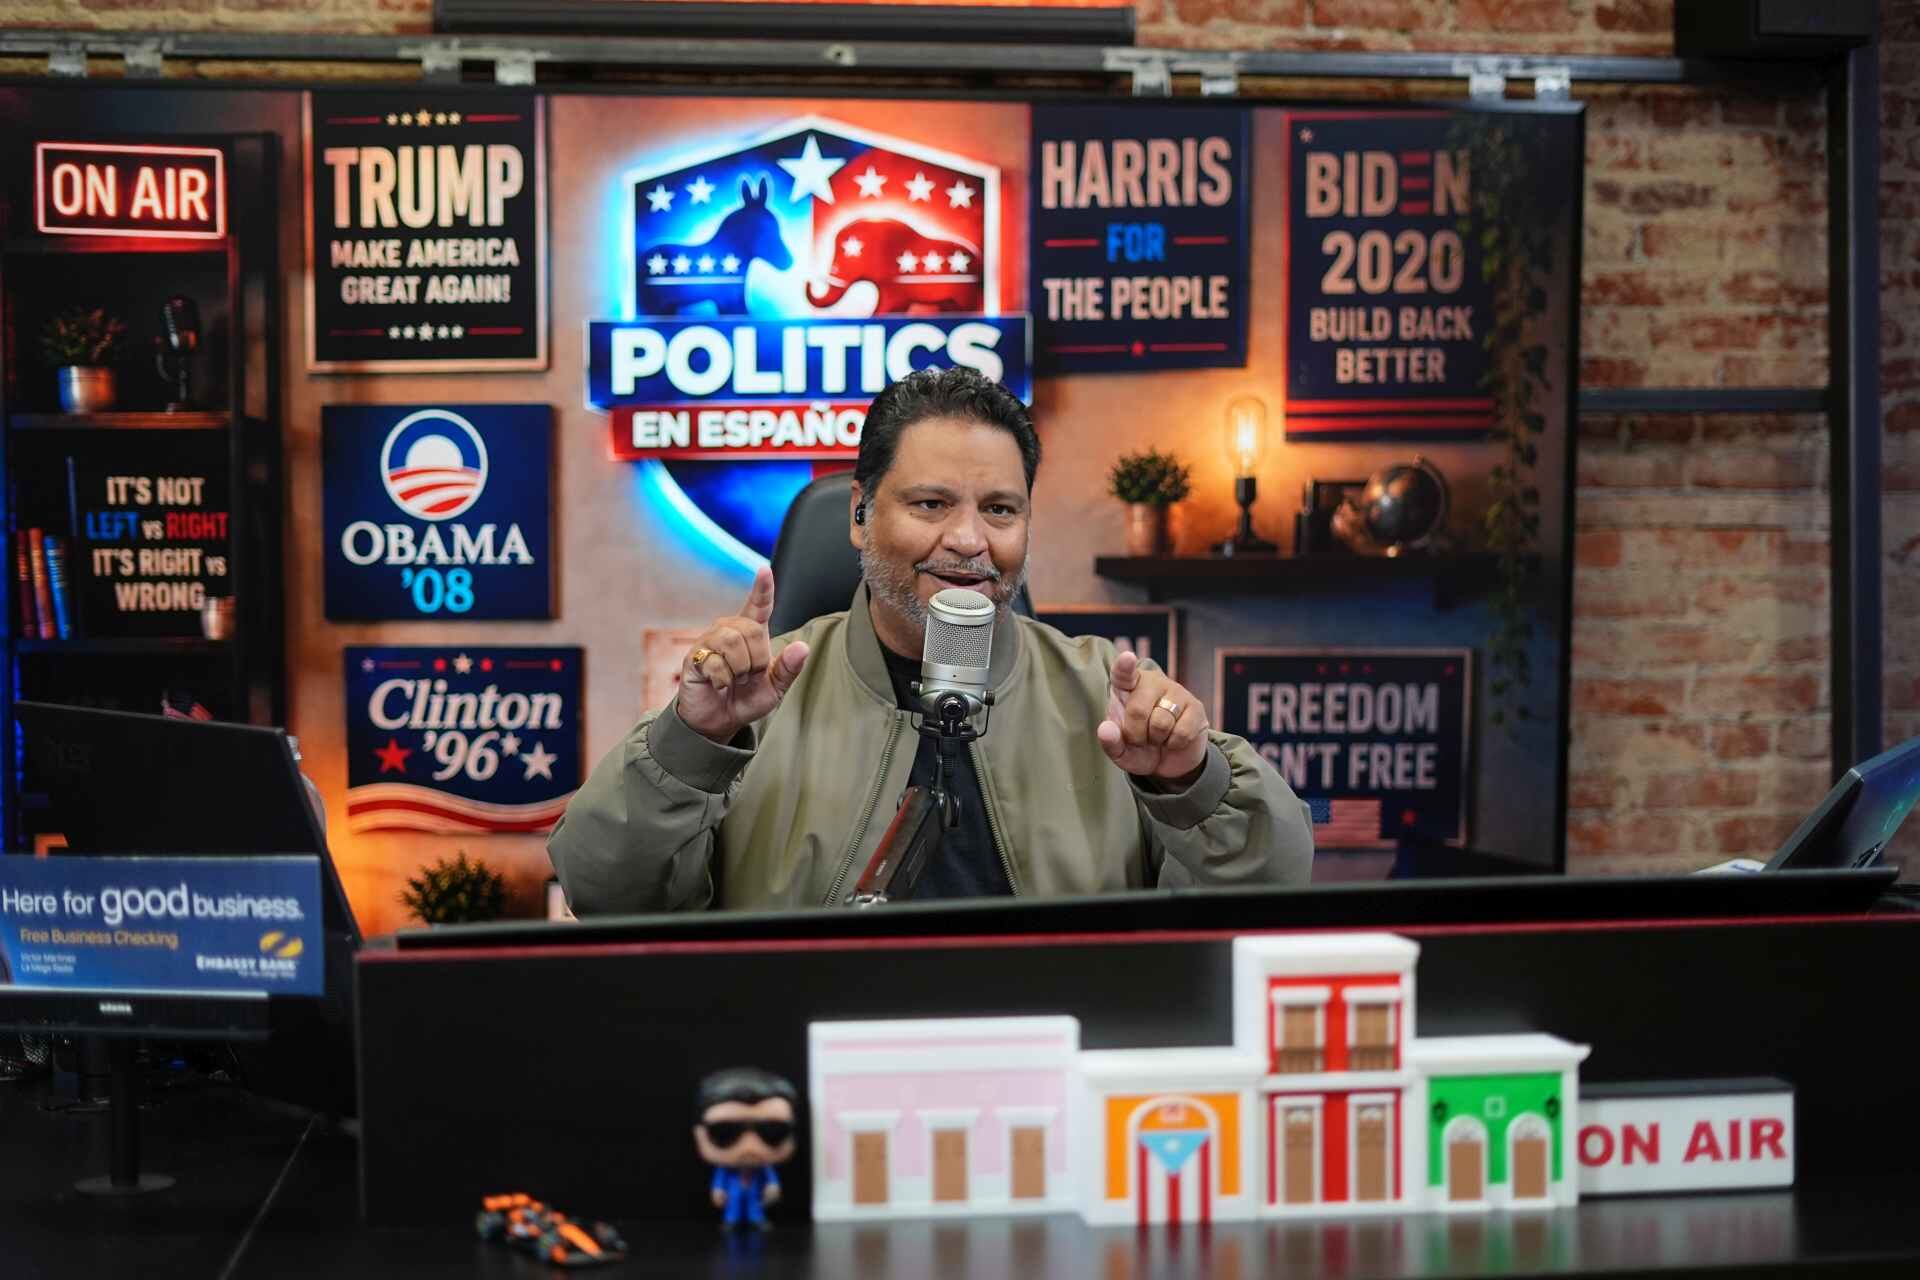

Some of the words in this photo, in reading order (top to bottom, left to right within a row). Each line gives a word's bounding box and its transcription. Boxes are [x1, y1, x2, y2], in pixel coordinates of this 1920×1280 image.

[52, 163, 117, 218] ON
[130, 166, 209, 222] AIR
[324, 144, 524, 229] TRUMP
[1041, 136, 1232, 210] HARRIS
[1305, 150, 1472, 219] BIDEN
[330, 239, 402, 269] MAKE
[406, 236, 520, 268] AMERICA
[1106, 222, 1167, 263] FOR
[1321, 229, 1466, 296] 2020
[341, 274, 420, 304] GREAT
[424, 274, 511, 305] AGAIN!
[1043, 278, 1104, 321] THE
[1110, 275, 1230, 320] PEOPLE
[1309, 307, 1392, 343] BUILD
[1399, 305, 1474, 341] BACK
[610, 323, 1004, 396] POLITICS
[1335, 347, 1447, 385] BETTER
[632, 411, 691, 448] EN
[699, 402, 866, 448] ESPAÑO
[106, 478, 152, 506] IT'S
[157, 478, 205, 505] NOT
[87, 514, 138, 540] LEFT
[166, 512, 228, 540] RIGHT
[340, 521, 535, 566] OBAMA
[93, 549, 136, 577] IT'S
[139, 548, 202, 577] RIGHT
[115, 581, 206, 612] WRONG
[368, 678, 563, 730] Clinton
[1247, 682, 1440, 733] FREEDOM
[1348, 743, 1437, 788] FREE
[2, 888, 58, 915] Here
[63, 889, 95, 916] for
[101, 882, 189, 925] good
[193, 892, 305, 919] business.
[20, 928, 49, 944] Free
[51, 928, 113, 946] Business
[114, 929, 179, 951] Checking
[196, 955, 256, 970] EMBASSY
[259, 958, 296, 970] BANK
[1577, 1122, 1660, 1167] ON
[1683, 1117, 1788, 1164] AIR
